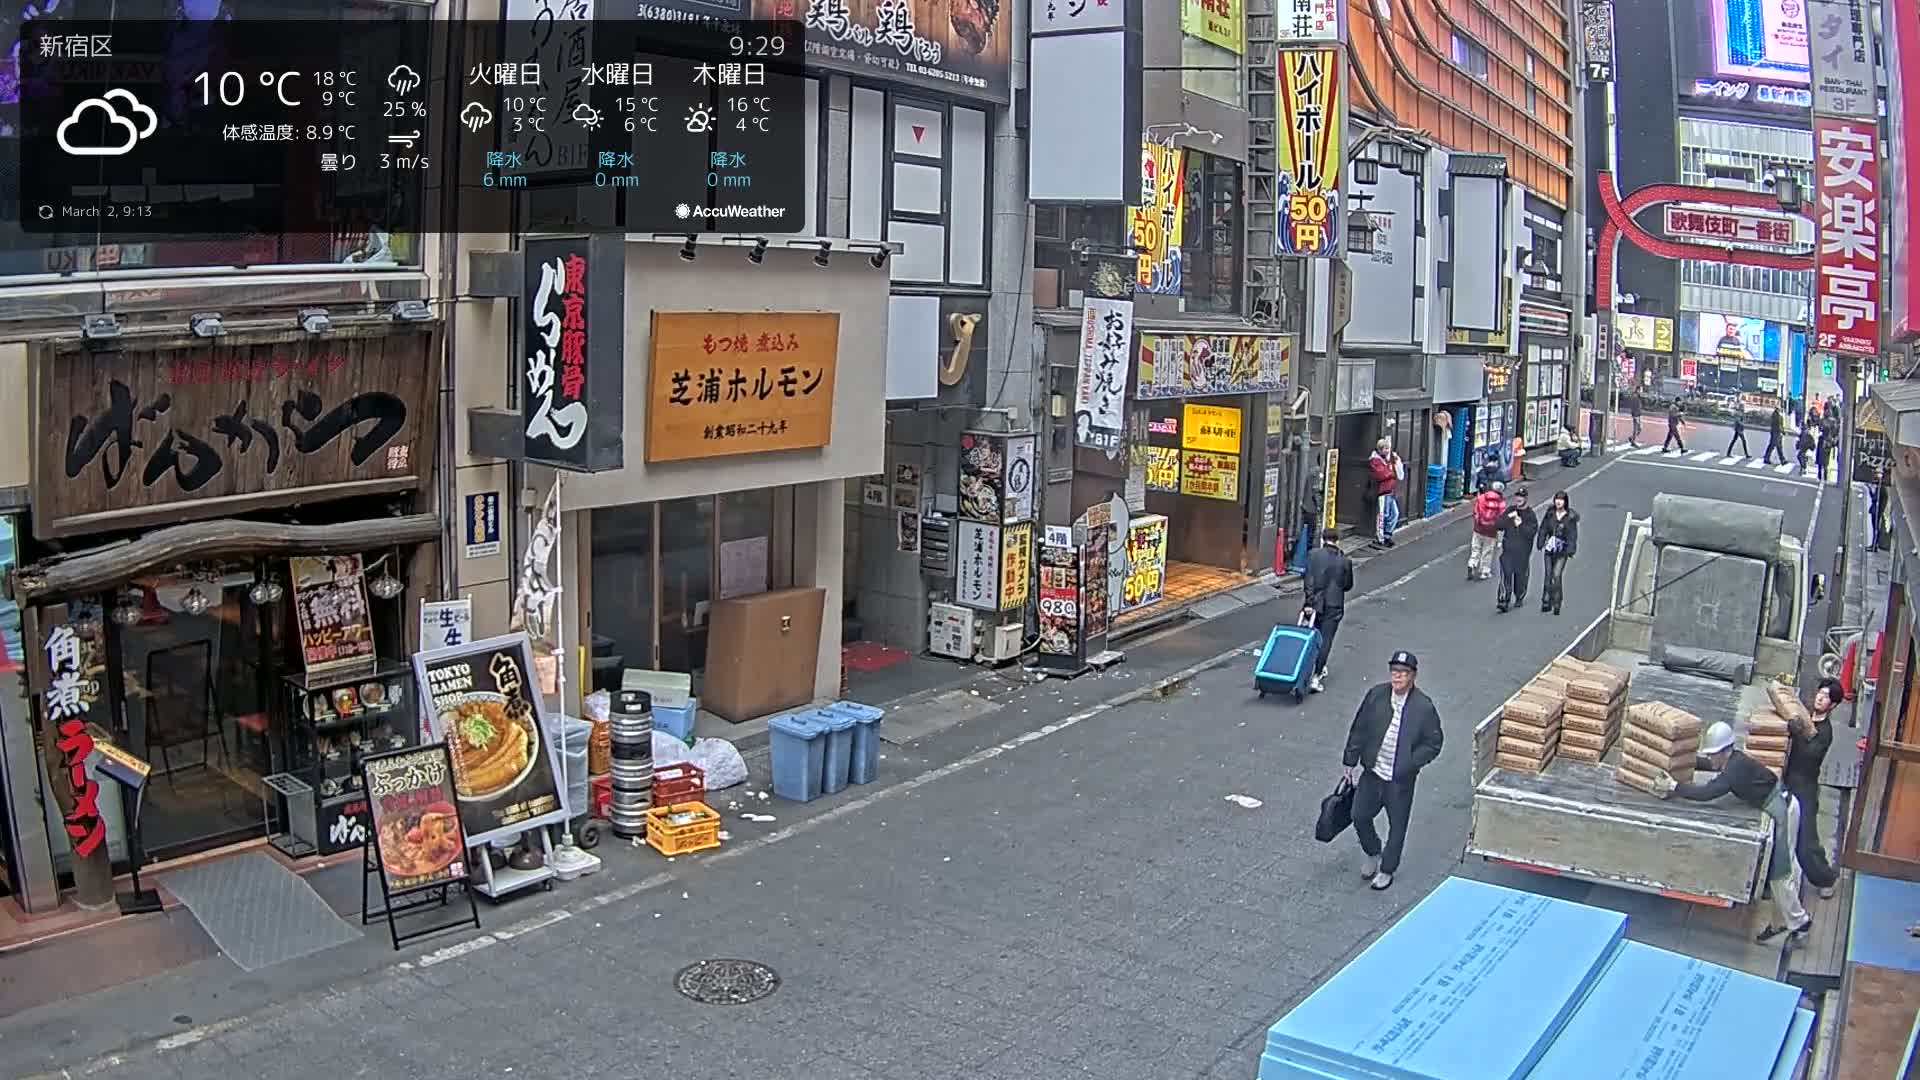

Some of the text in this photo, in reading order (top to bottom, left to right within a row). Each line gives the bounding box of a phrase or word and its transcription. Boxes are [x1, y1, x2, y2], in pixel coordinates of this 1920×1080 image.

[1818, 13, 1843, 70] タイ
[1590, 63, 1610, 79] 7F
[1832, 97, 1857, 112] 3F
[1294, 52, 1323, 191] ハイボール
[1290, 194, 1329, 252] 50円
[1670, 211, 1791, 242] 歌舞伎町一番街
[1819, 126, 1877, 330] 安楽亭
[561, 252, 586, 400] 東京豚骨
[703, 331, 800, 352] もつ焼 煮込み
[1818, 332, 1837, 348] 2F
[1094, 309, 1127, 416] お好み焼き
[669, 366, 824, 406] 芝浦ホルモン
[66, 379, 407, 492] ばんから
[703, 420, 789, 440] 創業昭和二十九年
[1095, 433, 1120, 448] B1F
[1123, 568, 1161, 602] 50円
[440, 607, 455, 628] 生
[427, 663, 471, 683] TOKYO
[431, 676, 473, 695] RAMEN
[433, 691, 465, 707] SHOP
[371, 761, 448, 797] ぶっかけ
[329, 813, 371, 845] ばん
